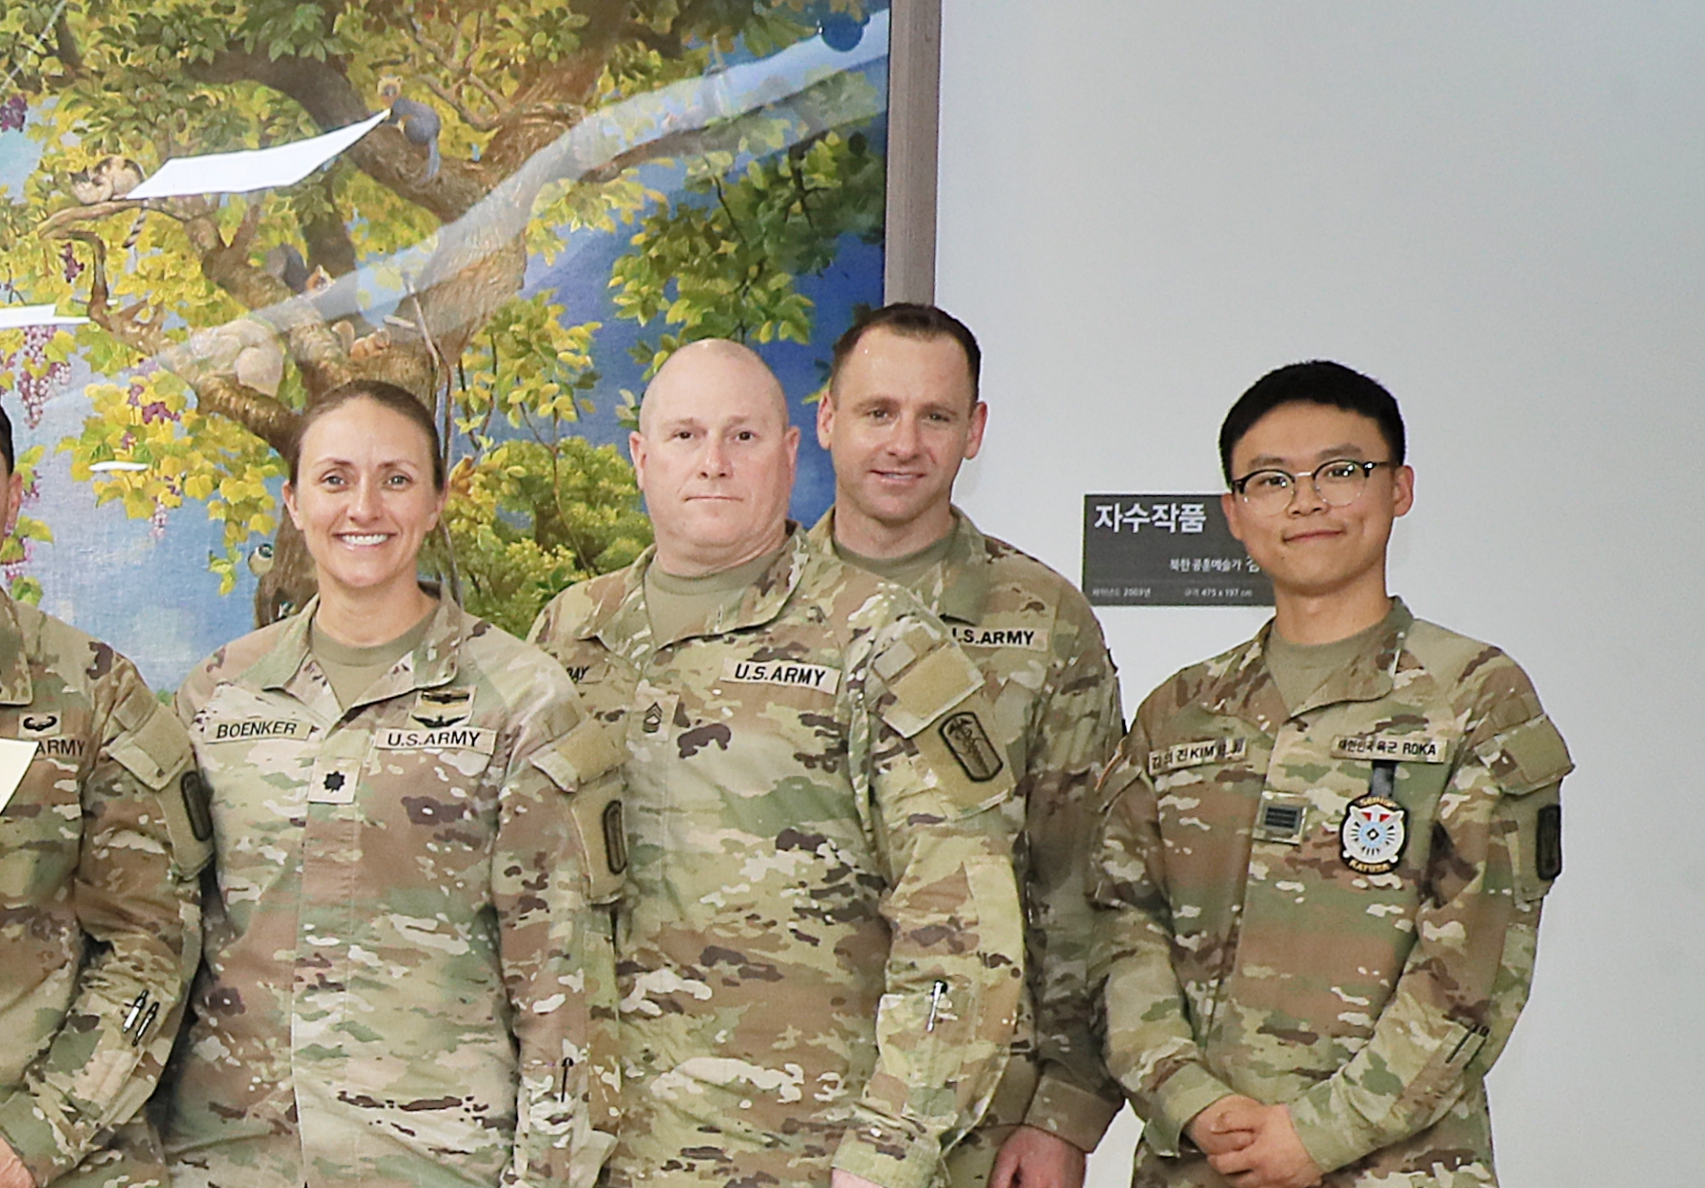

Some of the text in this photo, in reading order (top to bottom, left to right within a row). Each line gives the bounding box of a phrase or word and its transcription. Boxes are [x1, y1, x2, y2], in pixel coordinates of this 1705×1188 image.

[1093, 502, 1207, 534] 자수작품
[216, 721, 298, 739] BOENKER
[1190, 745, 1215, 759] KIM
[1402, 742, 1436, 755] ROKA
